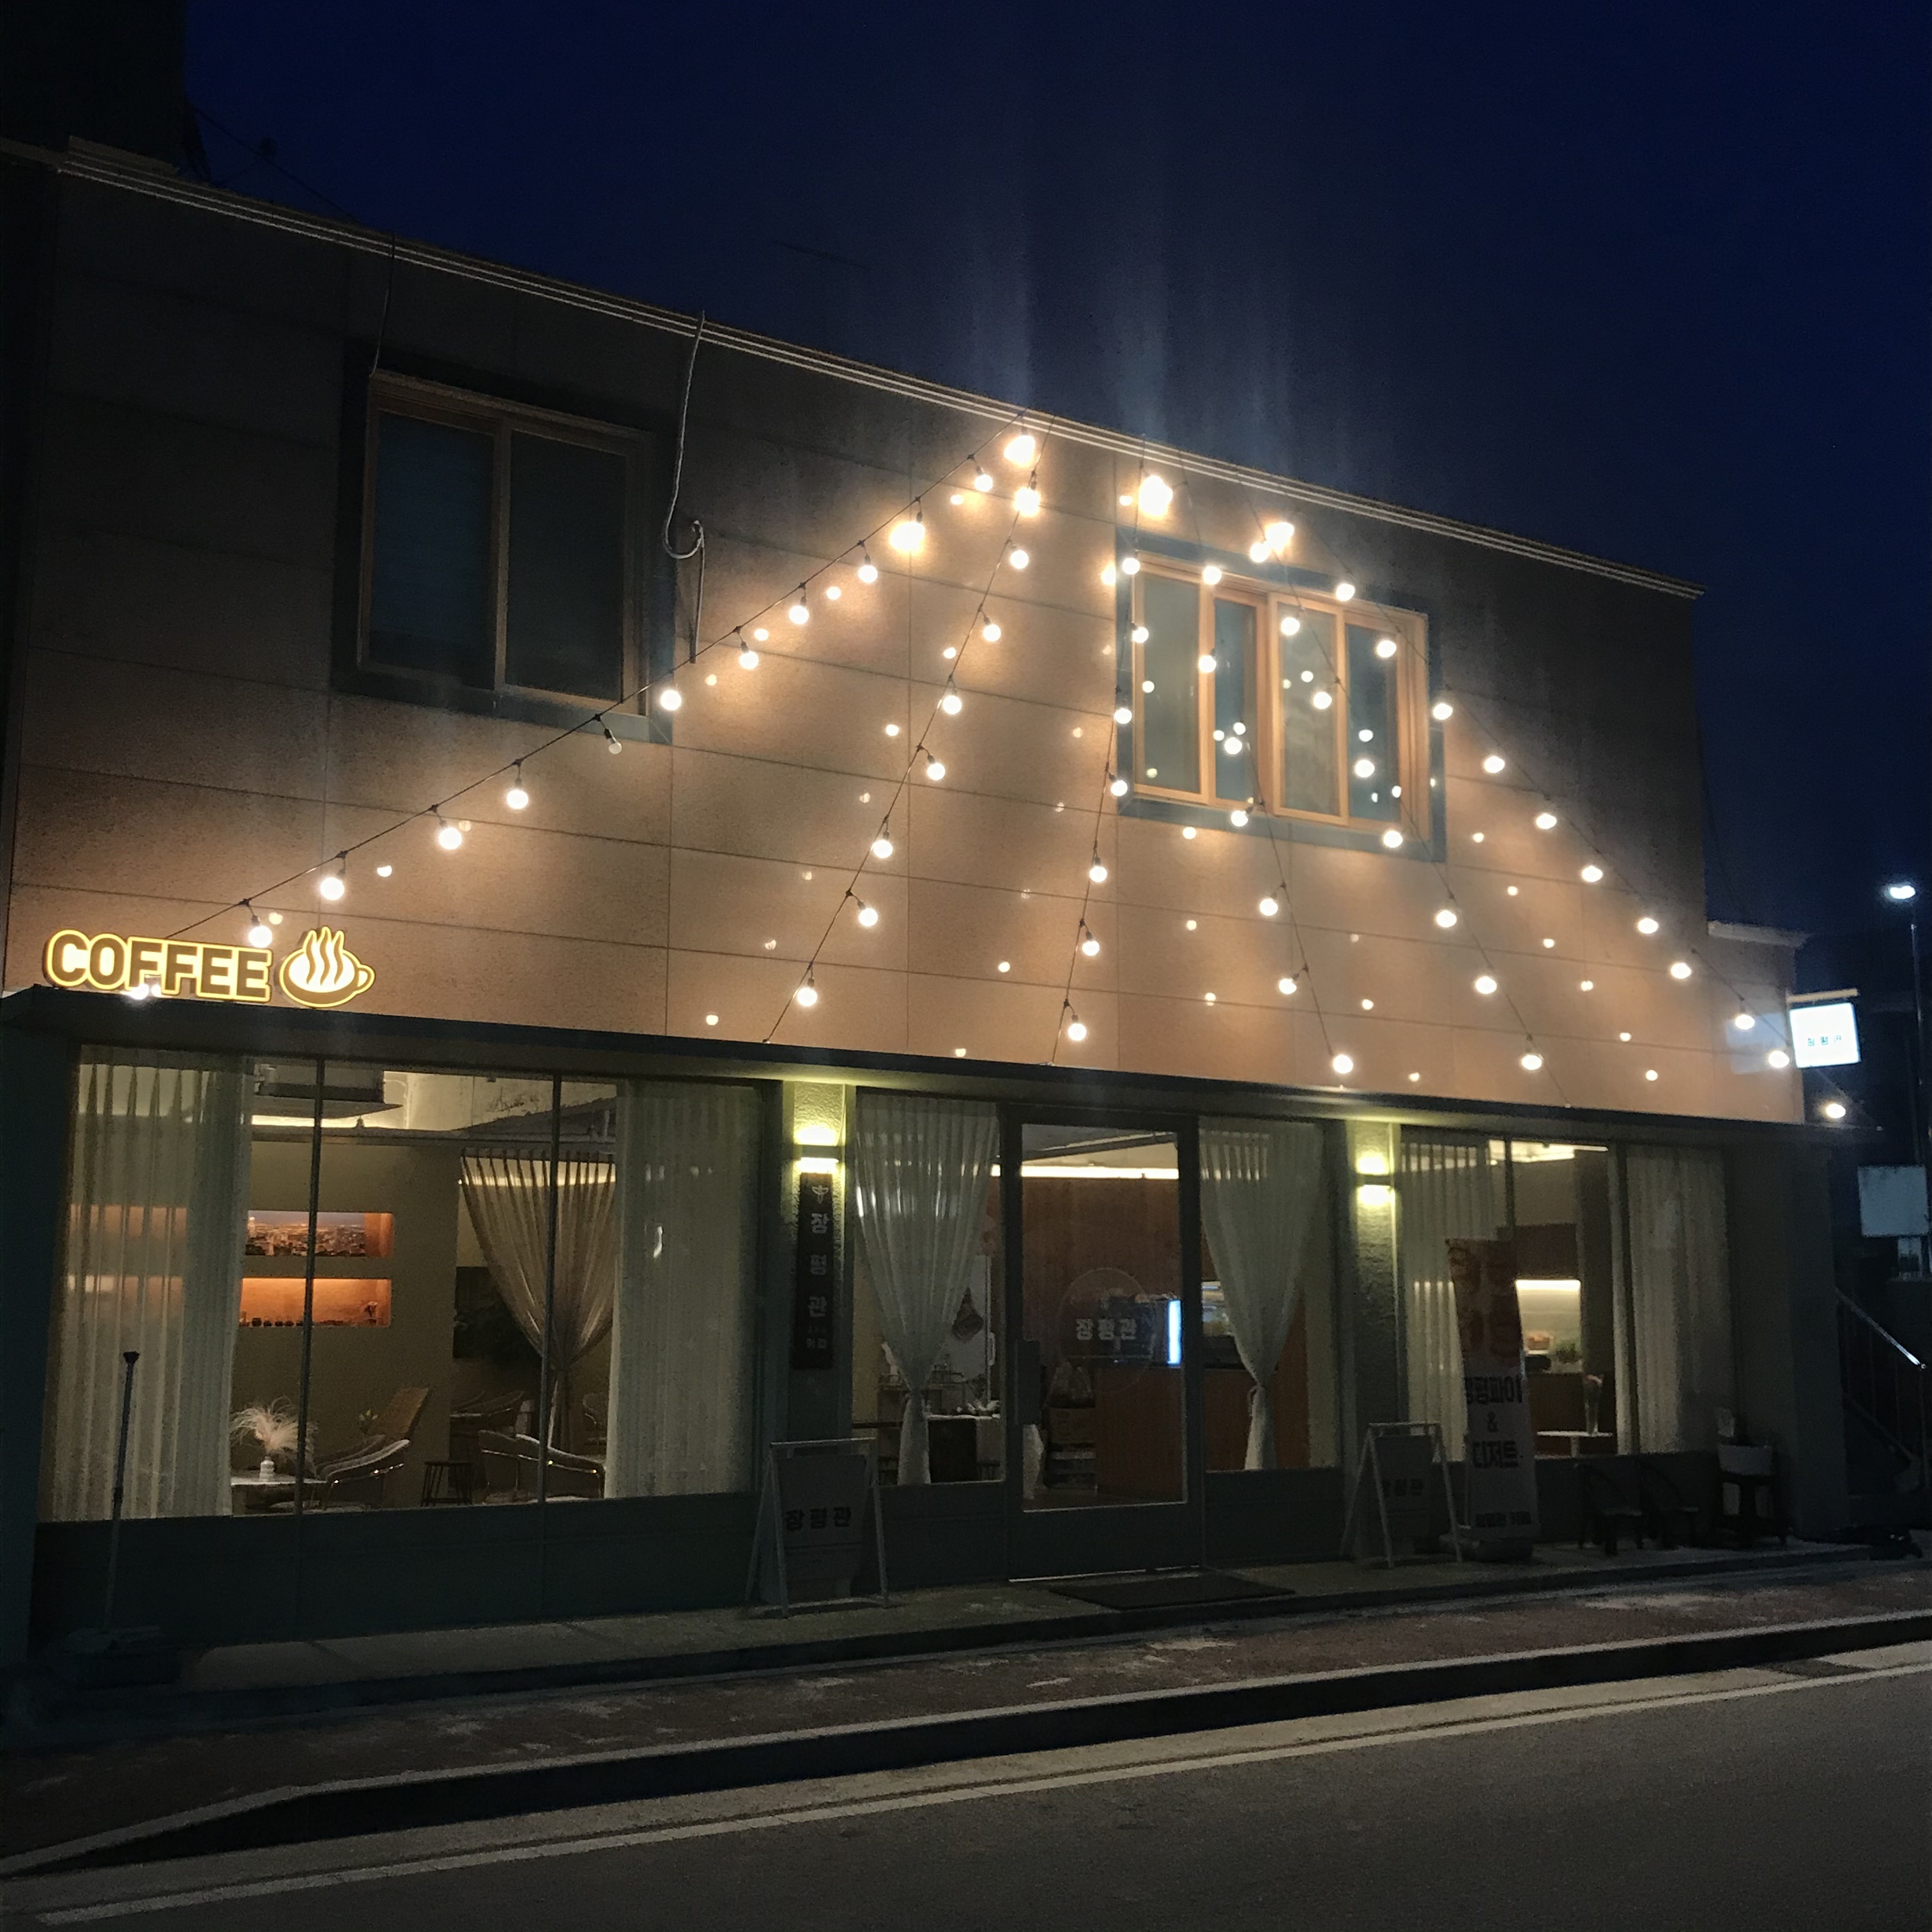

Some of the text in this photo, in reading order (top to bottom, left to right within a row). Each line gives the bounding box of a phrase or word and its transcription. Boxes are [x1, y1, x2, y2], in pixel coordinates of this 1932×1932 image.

[46, 929, 273, 1002] COFFEE
[1487, 1411, 1498, 1432] &
[1472, 1440, 1519, 1469] 디저트
